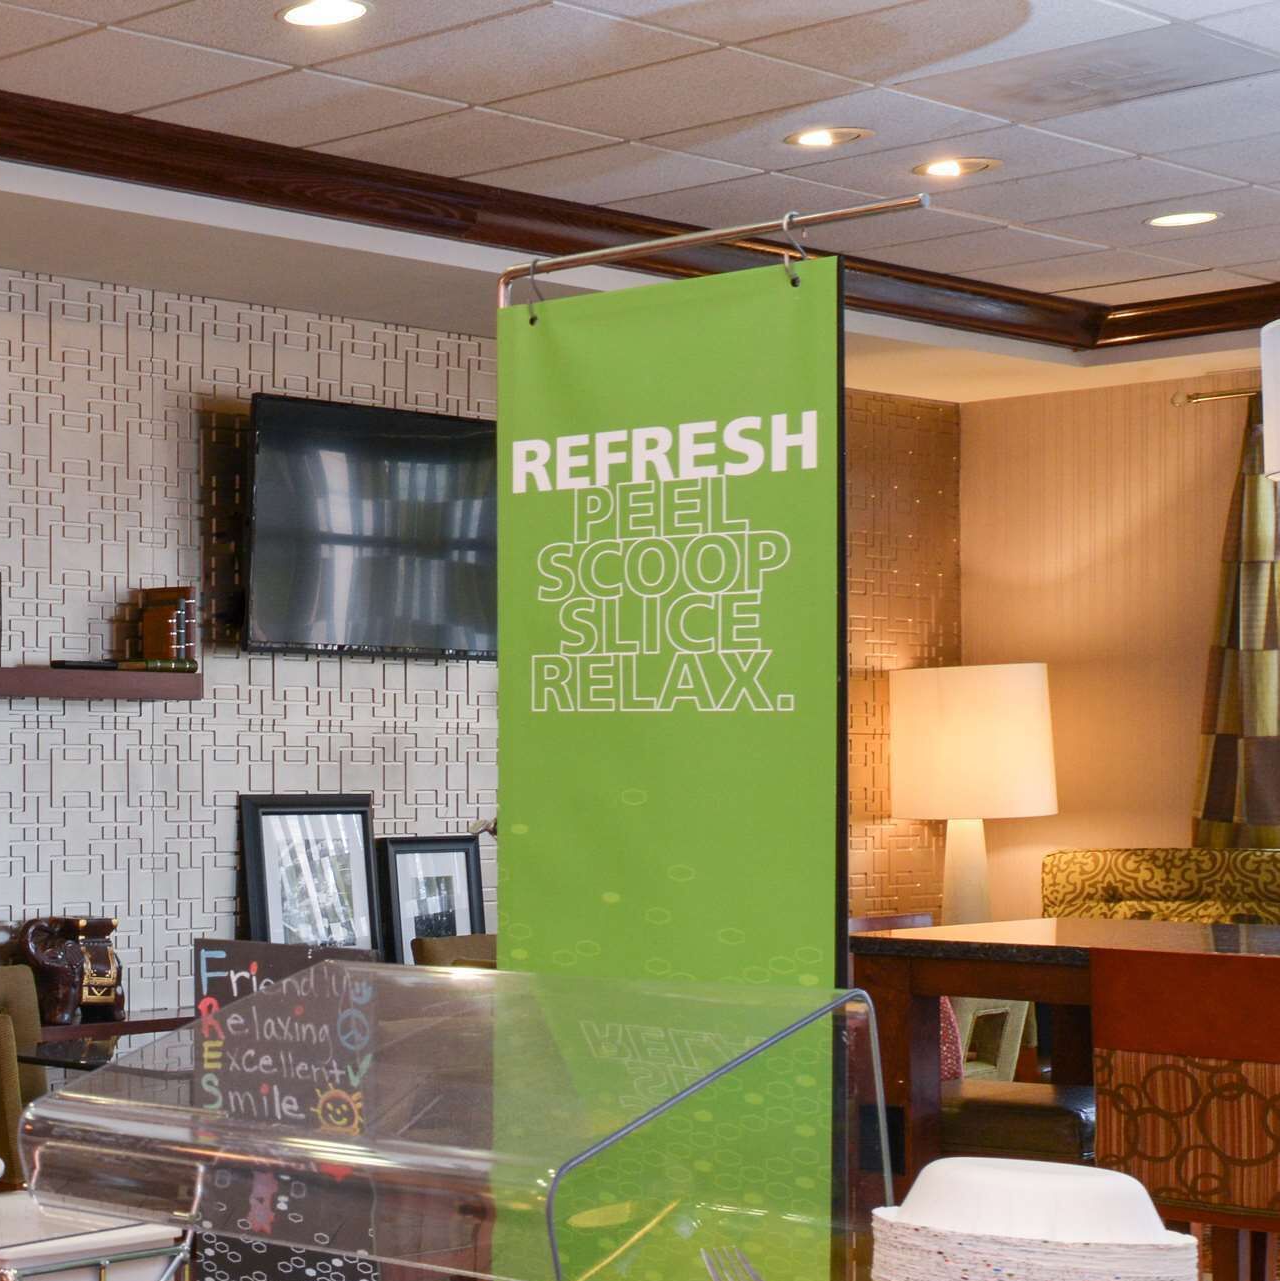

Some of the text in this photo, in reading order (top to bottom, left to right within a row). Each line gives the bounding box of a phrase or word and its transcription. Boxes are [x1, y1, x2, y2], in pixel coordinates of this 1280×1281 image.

[512, 410, 818, 494] REFRESH
[573, 474, 749, 544] PEEL
[537, 530, 791, 602] SCOOP
[559, 592, 762, 656] SLICE
[531, 649, 795, 712] RELAX.
[200, 949, 354, 1012] Friendly
[198, 997, 334, 1064] Relaxing
[203, 1040, 346, 1084] Excellent
[201, 1072, 306, 1120] Smile
